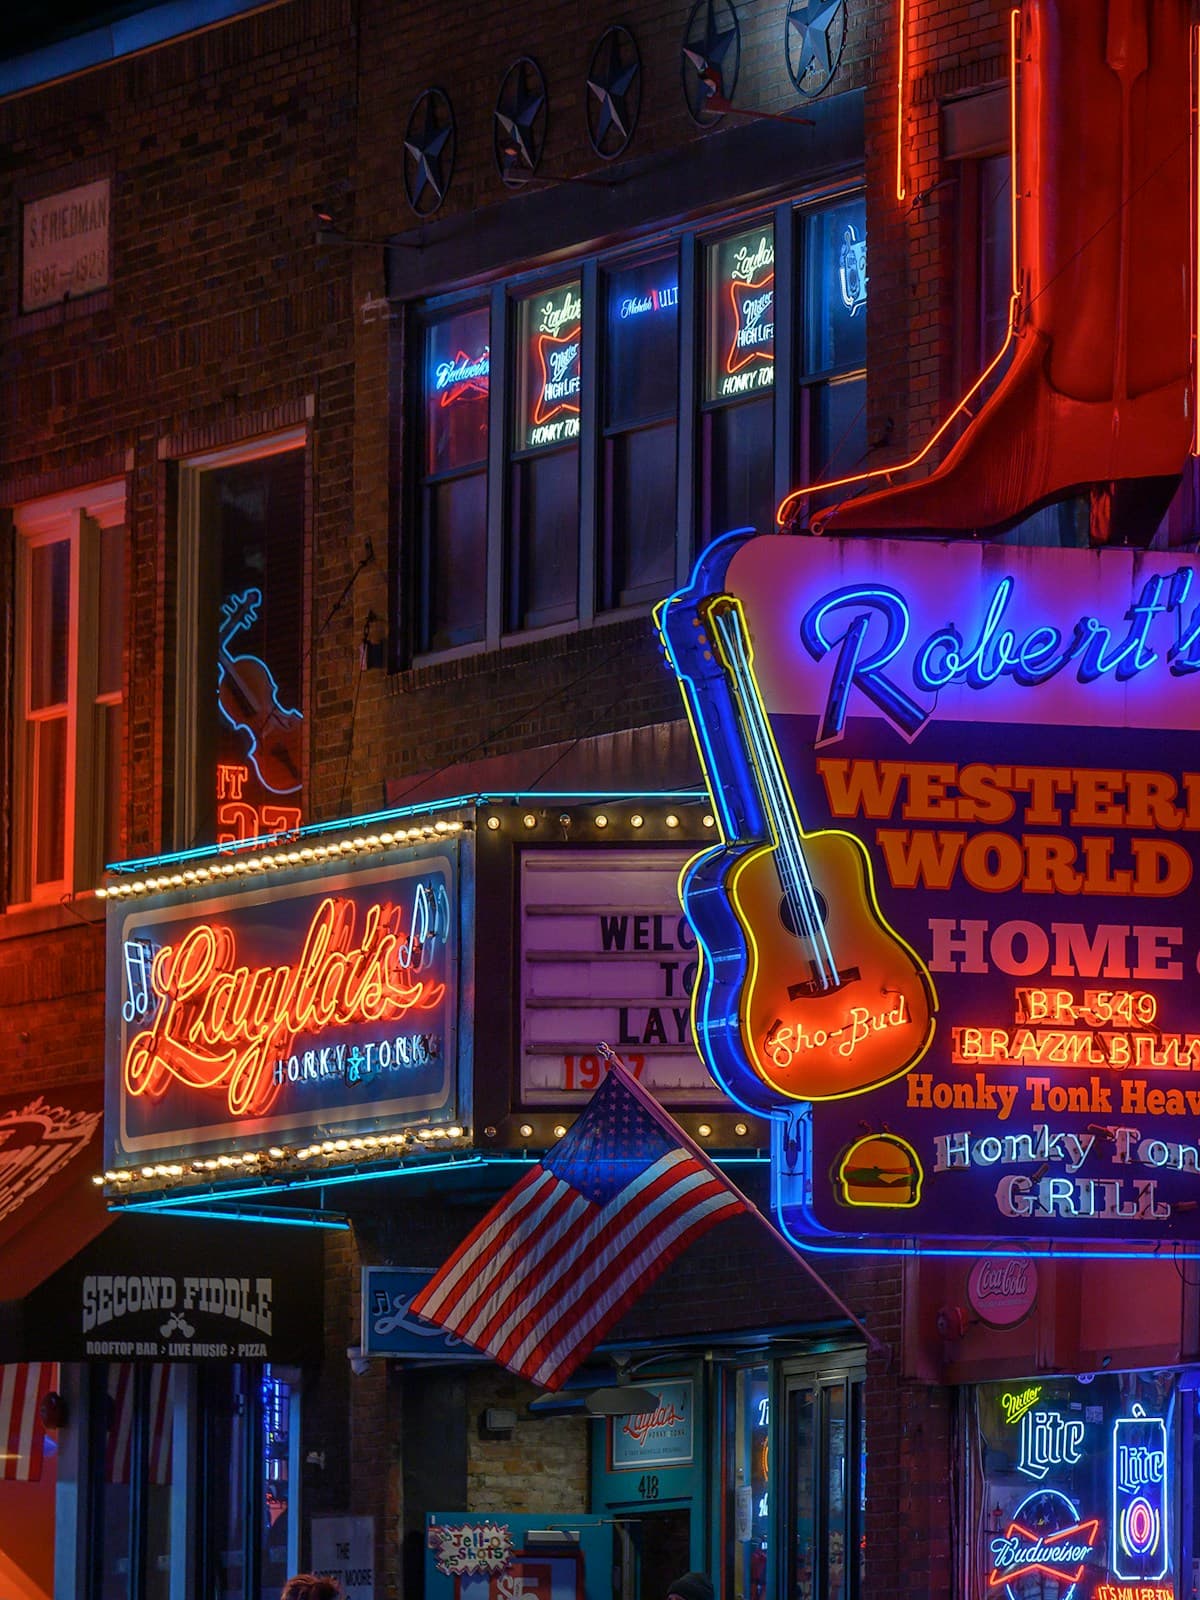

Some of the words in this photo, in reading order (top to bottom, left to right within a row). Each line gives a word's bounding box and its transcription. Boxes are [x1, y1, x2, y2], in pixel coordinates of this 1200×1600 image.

[737, 328, 758, 348] HIGH
[544, 381, 565, 401] HIGH
[723, 371, 757, 395] HONKY
[531, 423, 565, 445] HONKY
[876, 828, 1193, 898] WORLD
[928, 917, 1184, 980] HOME
[125, 898, 432, 1116] Layla's
[1015, 985, 1158, 1029] BR-549
[767, 995, 907, 1067] Sho-Bud
[273, 1043, 347, 1085] HONKY
[364, 1034, 430, 1070] TONK
[564, 1055, 646, 1090] 197
[906, 1073, 1018, 1119] Honky
[1025, 1077, 1112, 1114] Tonk
[933, 1124, 1098, 1174] Honky
[994, 1174, 1172, 1220] GRILL
[977, 1260, 1030, 1299] Coca-Cola
[83, 1275, 176, 1334] SECOND
[183, 1277, 272, 1336] FIDDLE
[86, 1341, 135, 1355] ROOFTOP
[136, 1342, 158, 1356] BAR
[168, 1343, 191, 1357] LIVE
[192, 1343, 228, 1357] MUSIC
[238, 1343, 267, 1357] PIZZA
[1002, 1386, 1042, 1424] Miller
[1017, 1411, 1085, 1480] Lite
[638, 1475, 659, 1499] 418
[1118, 1445, 1164, 1495] Lite
[452, 1532, 501, 1548] Jell-o
[458, 1546, 503, 1561] Shots
[990, 1537, 1093, 1567] Budweiser
